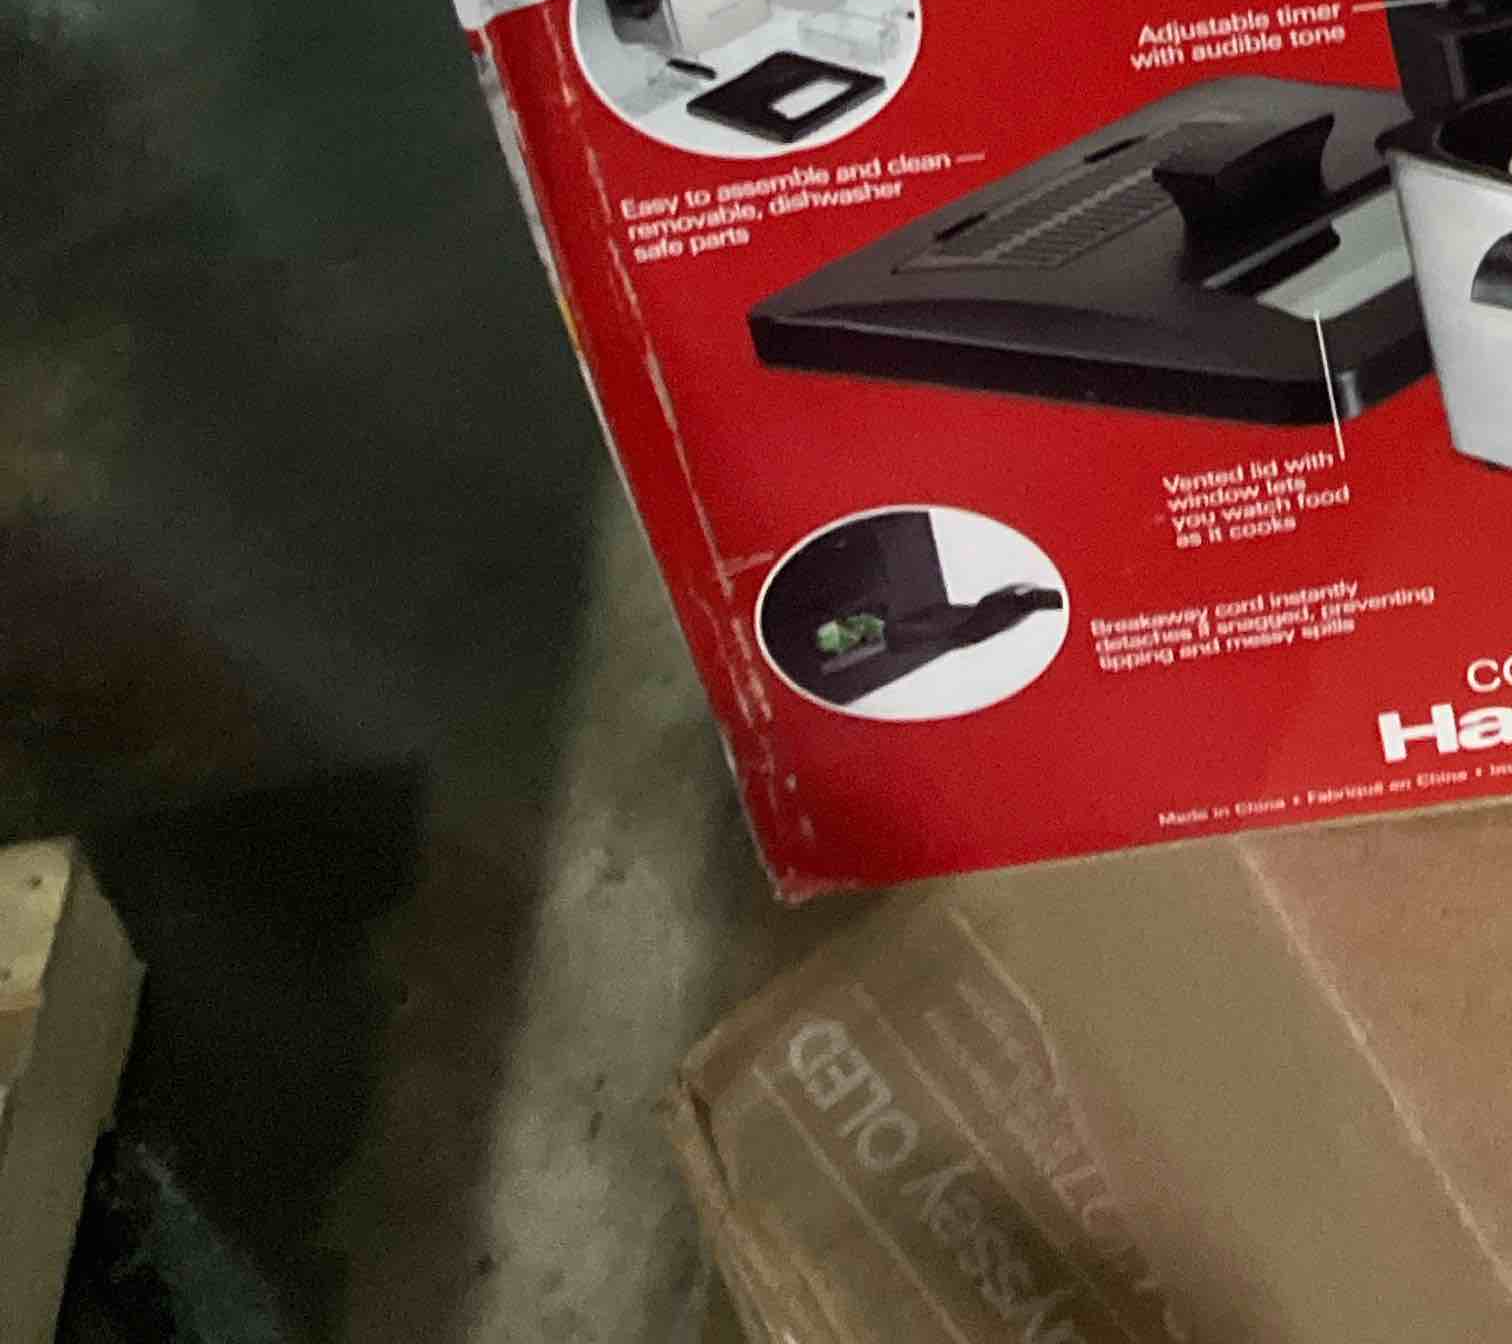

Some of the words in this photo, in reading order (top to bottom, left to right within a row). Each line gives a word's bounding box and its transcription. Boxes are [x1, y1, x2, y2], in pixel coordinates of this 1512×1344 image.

[1138, 9, 1270, 47] Adjustable
[1277, 2, 1342, 23] timer
[1130, 43, 1185, 71] with
[1191, 30, 1283, 62] audible
[1290, 24, 1346, 48] tone
[620, 195, 678, 221] Easy
[684, 188, 711, 209] to
[717, 166, 831, 201] assemble
[836, 157, 882, 183] and
[887, 151, 952, 176] clean
[627, 203, 763, 241] removable,
[768, 180, 903, 216] dishwasher
[633, 237, 683, 264] safe
[690, 227, 750, 256] parts
[1162, 464, 1244, 494] Vented
[1250, 459, 1278, 480] lid
[1284, 449, 1334, 474] with
[1167, 484, 1260, 512] window
[1266, 478, 1307, 496] lets
[1172, 512, 1216, 532] you
[1221, 496, 1291, 522] watch
[1298, 483, 1350, 510] food
[1176, 533, 1202, 548] as
[1208, 526, 1222, 542] it
[1229, 516, 1297, 540] cooks
[1090, 608, 1208, 636] Breakaway
[1216, 595, 1264, 617] cord
[1269, 580, 1358, 610] instantly
[1321, 586, 1435, 619] preventing
[1179, 638, 1220, 659] and
[1213, 805, 1230, 819] in
[1235, 798, 1286, 816] China
[787, 1018, 921, 1172] OLED
